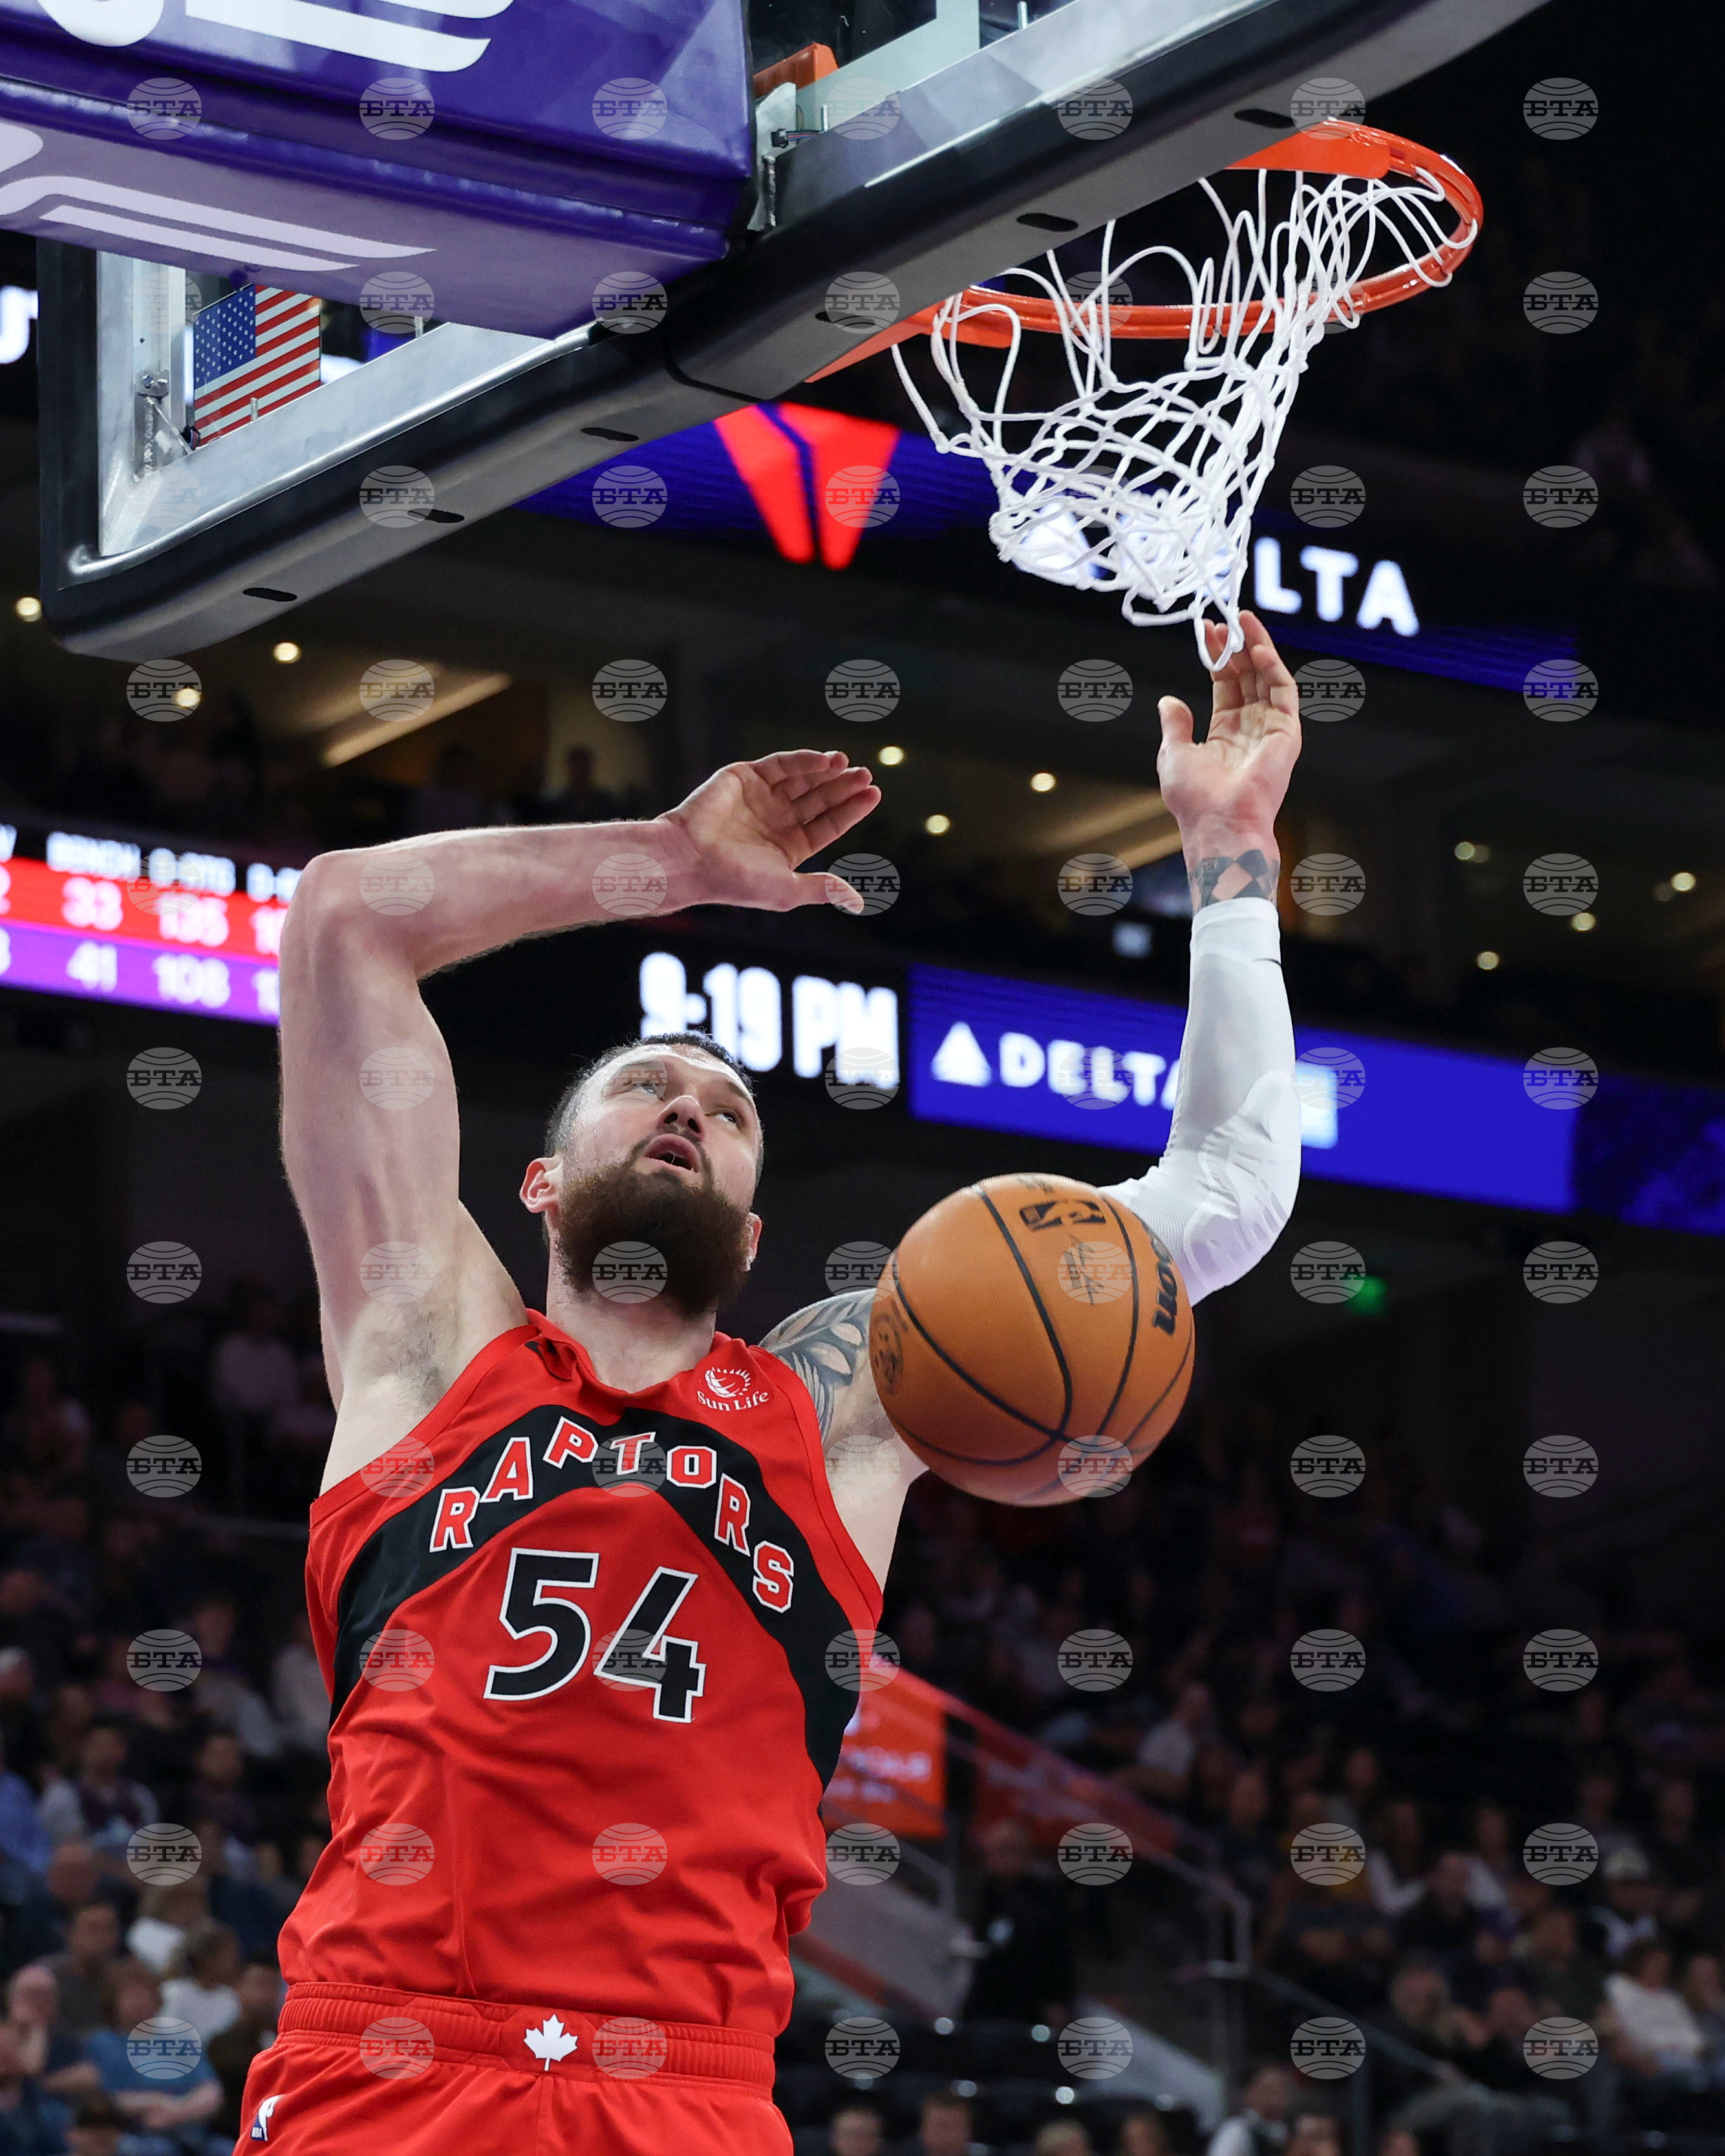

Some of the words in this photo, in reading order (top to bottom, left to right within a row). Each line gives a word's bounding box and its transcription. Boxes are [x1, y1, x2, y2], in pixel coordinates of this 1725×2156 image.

[791, 975, 900, 1090] PM
[697, 1391, 731, 1411] Sun
[733, 1391, 769, 1411] Life
[429, 1416, 793, 1613] RAPTORS
[484, 1548, 707, 1723] 54
